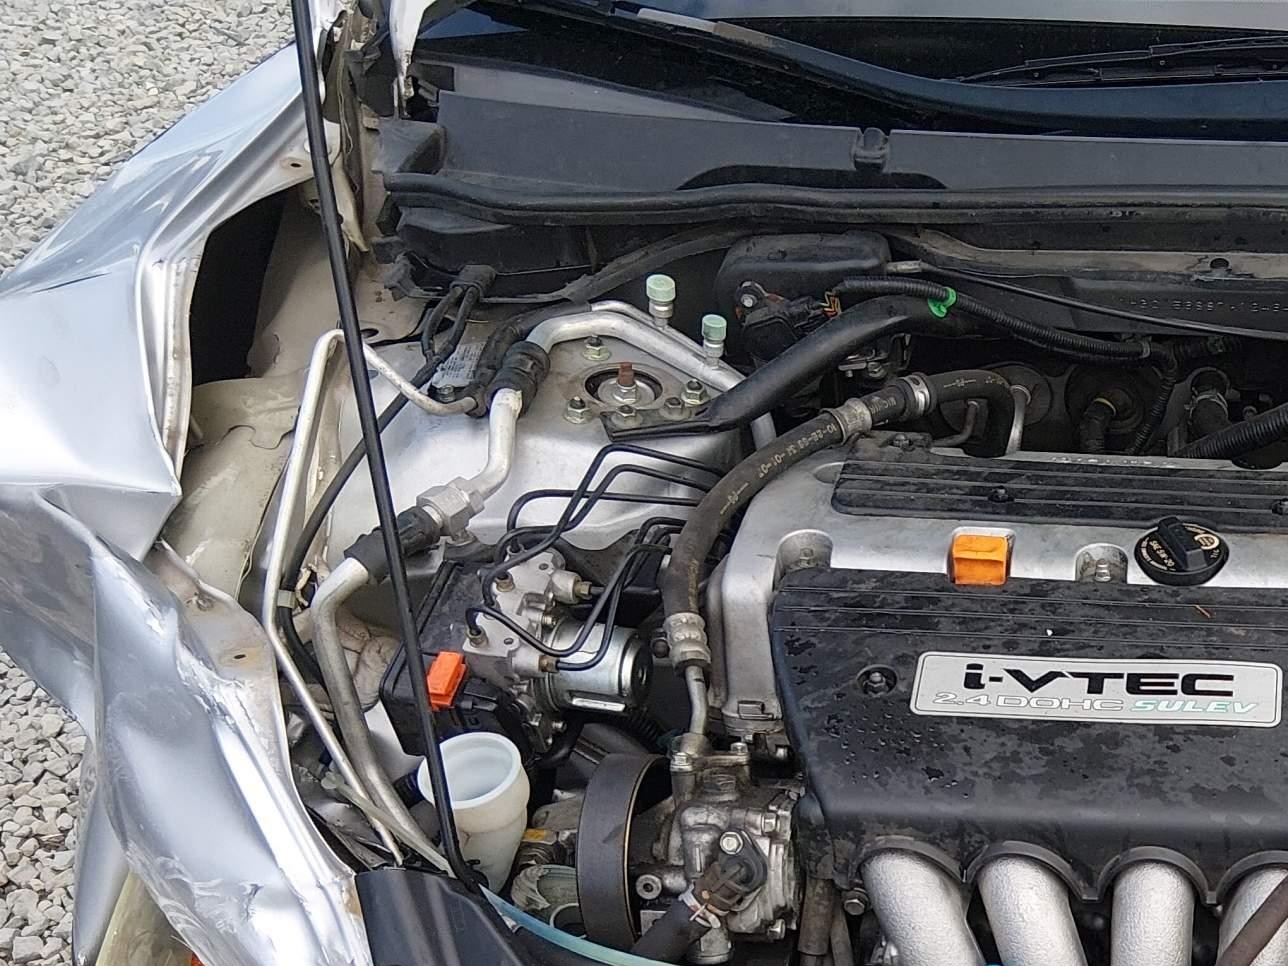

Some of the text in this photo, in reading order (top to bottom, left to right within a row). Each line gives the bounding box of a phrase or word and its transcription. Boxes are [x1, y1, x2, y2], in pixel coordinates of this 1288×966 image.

[963, 663, 1234, 697] i-VTEC
[932, 691, 1257, 714] 2.4 DOHC SULEV
